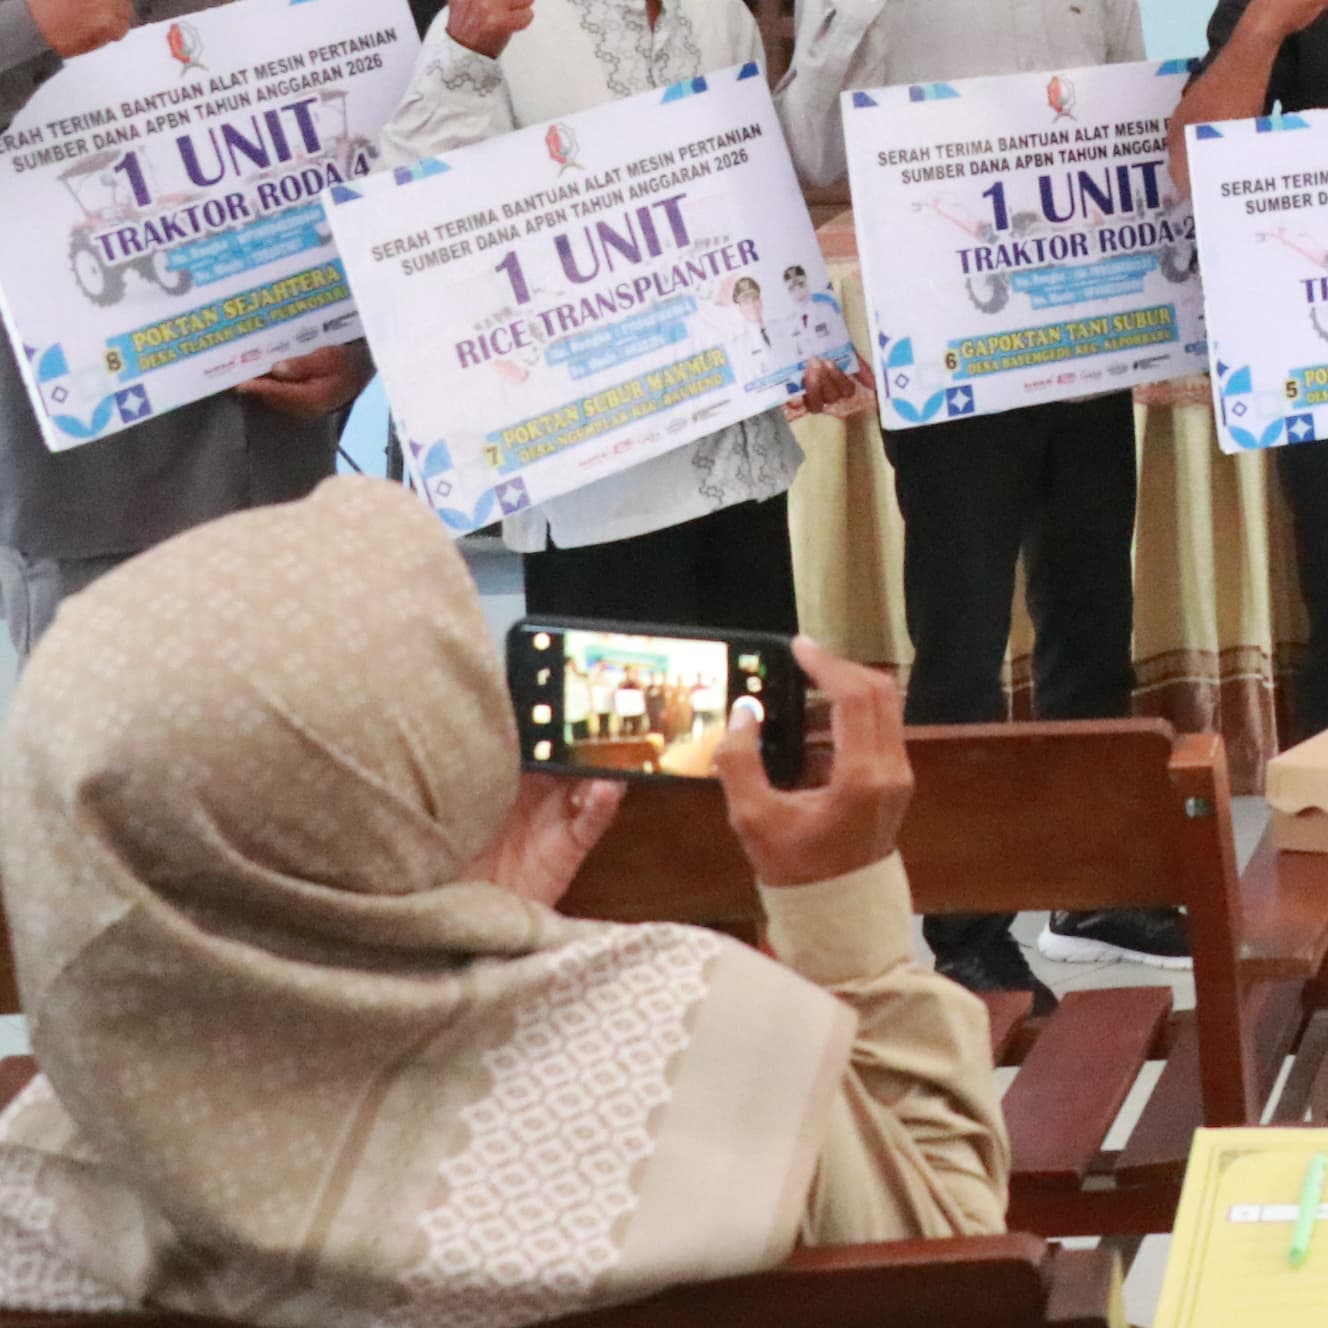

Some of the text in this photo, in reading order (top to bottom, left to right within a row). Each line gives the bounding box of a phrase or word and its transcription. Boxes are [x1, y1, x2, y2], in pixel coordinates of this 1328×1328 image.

[0, 27, 397, 158] RAH TERIMA BANTUAN ALAT MESIN PERTANIAN
[114, 98, 321, 206] 1 UNIT
[878, 119, 1159, 166] SERAH TERIMA BANTUAN ALAT MESIN
[100, 193, 249, 260] TRAKTOR
[257, 163, 345, 209] RODA
[344, 150, 372, 183] 4
[371, 122, 762, 261] SERAH TERIMA BANTUAN ALAT MESIN PERTANIAN
[982, 161, 1163, 230] 1 UNIT
[1220, 177, 1276, 197] SERAH
[1245, 192, 1312, 214] SUMBER
[495, 194, 690, 304] 1 UNIT
[960, 217, 1199, 273] TRAKTOR RODA 2
[131, 263, 340, 352] POKTAN SEJAHTERA
[456, 322, 523, 367] RICE
[539, 238, 759, 336] TRANSPLANTER
[960, 308, 1170, 358] GAPOKTAN TANI SUBUR
[103, 350, 123, 373] 8
[944, 352, 957, 370] 6
[1285, 381, 1298, 399] 5
[502, 403, 581, 449] POKTAN
[485, 445, 502, 466] 7
